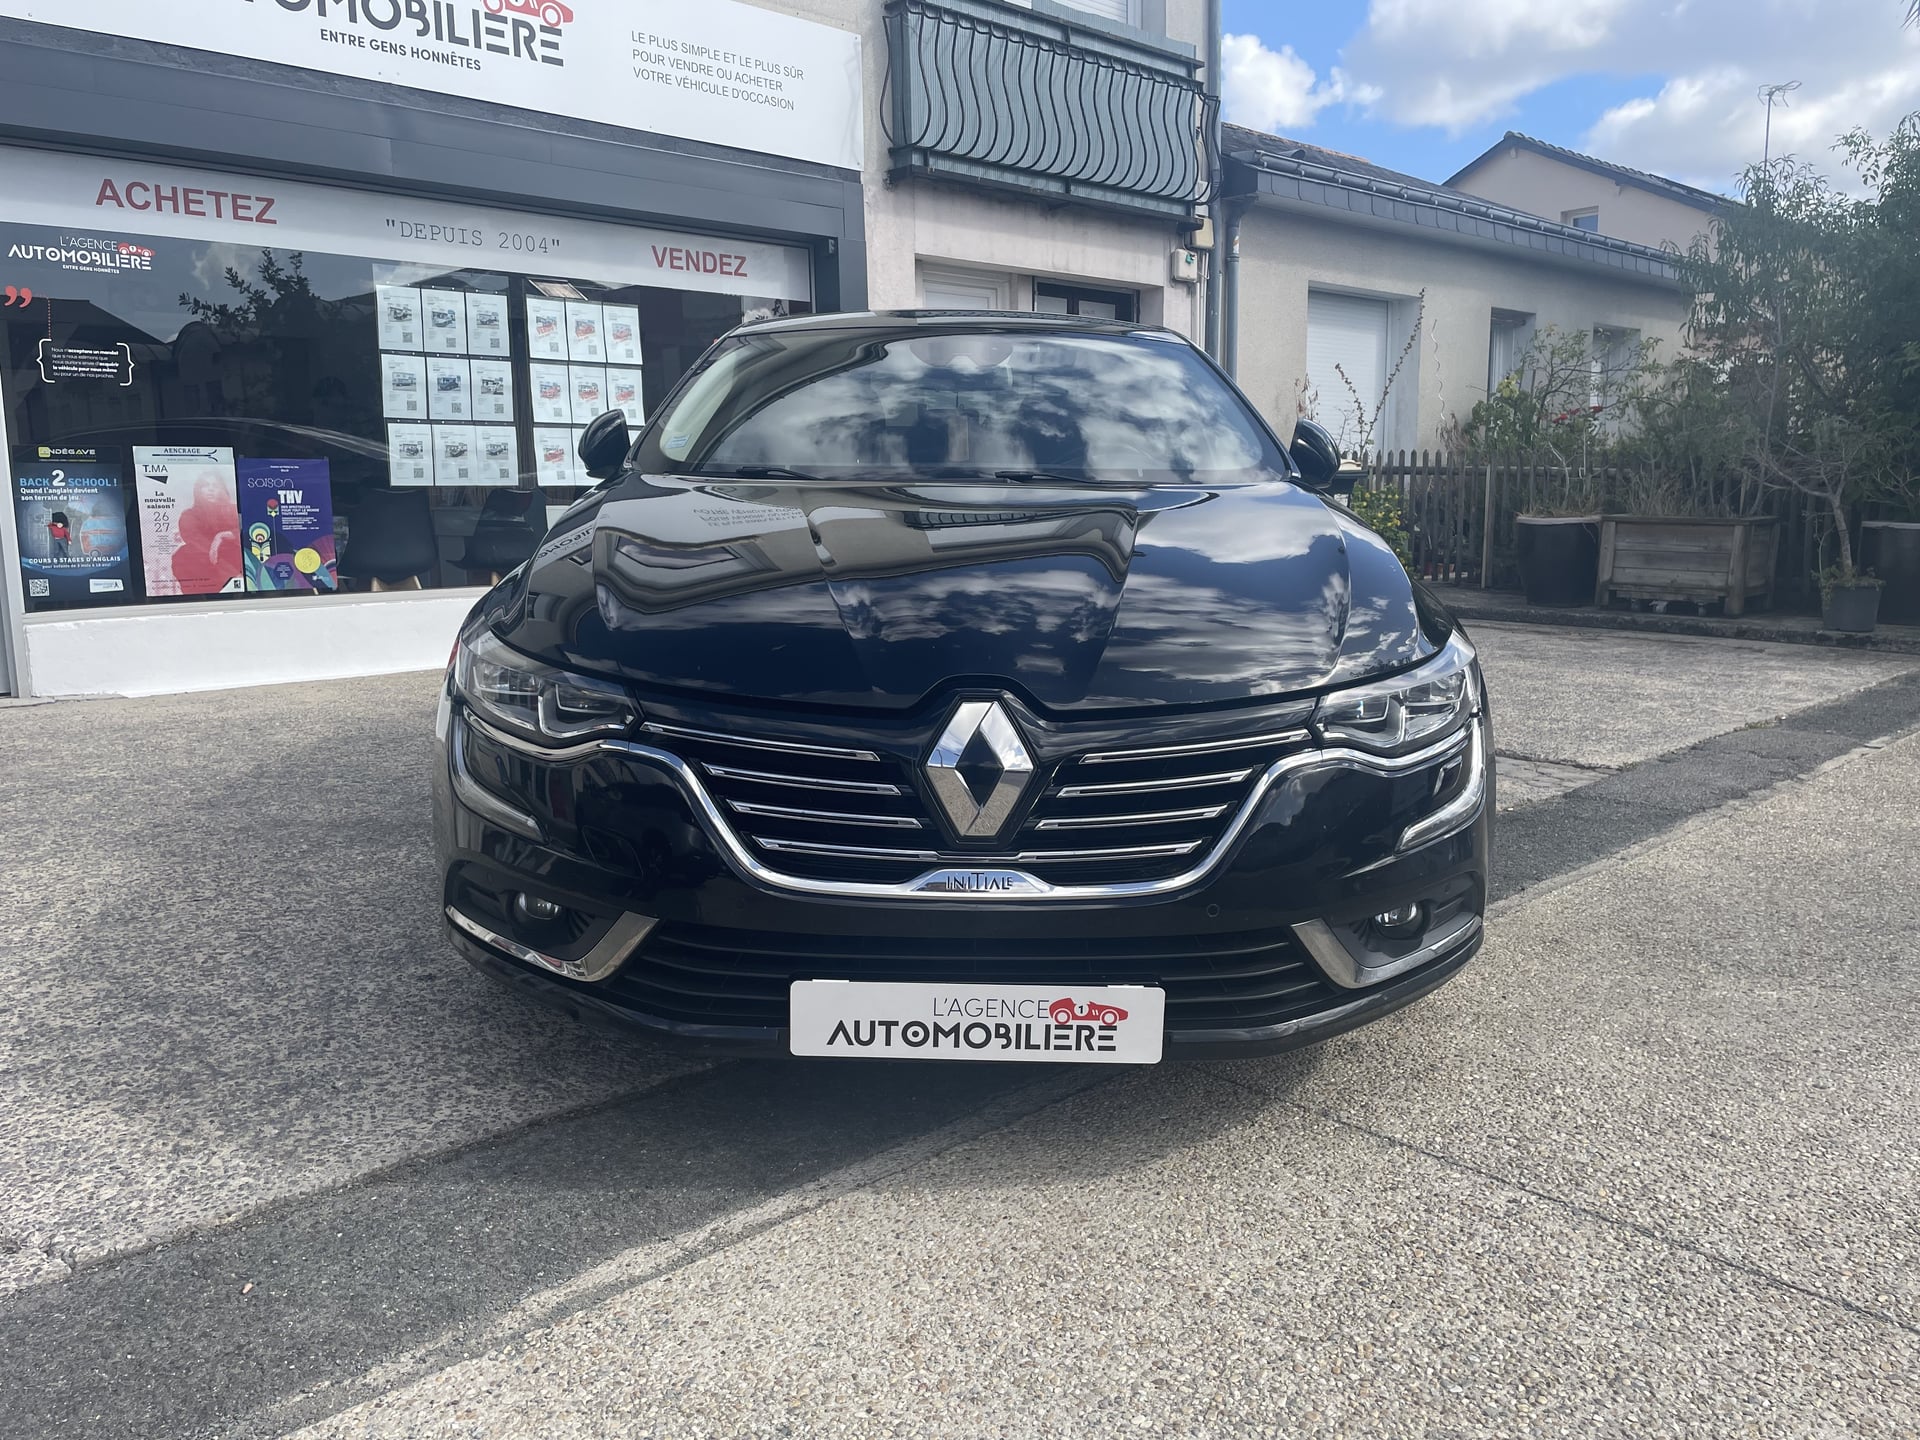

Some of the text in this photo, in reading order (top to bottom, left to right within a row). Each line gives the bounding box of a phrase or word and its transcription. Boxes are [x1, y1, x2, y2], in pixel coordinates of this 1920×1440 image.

[320, 28, 481, 71] ENTRE GENS HONNÊTES
[631, 30, 804, 80] LE PLUS SIMPLE ET LE PLUS SÛR
[632, 49, 783, 91] POUR VENDRE OU ACHETER
[633, 66, 795, 111] VOTRE VÉHICULE D'OCCASION
[95, 178, 277, 224] ACHETEZ
[59, 236, 118, 251] L'AGENCE
[385, 218, 560, 254] "DEPUIS 2004"
[651, 245, 748, 277] VENDEZ
[20, 478, 49, 487] BACK
[51, 469, 66, 487] 2
[68, 478, 111, 487] SCHOOL
[142, 464, 168, 473] T.MA
[43, 487, 72, 495] l'anglais
[277, 490, 303, 504] THV
[153, 511, 170, 522] 26
[154, 522, 170, 533] 27
[947, 872, 1013, 890] INITIALE
[932, 997, 1050, 1019] L'AGENCE
